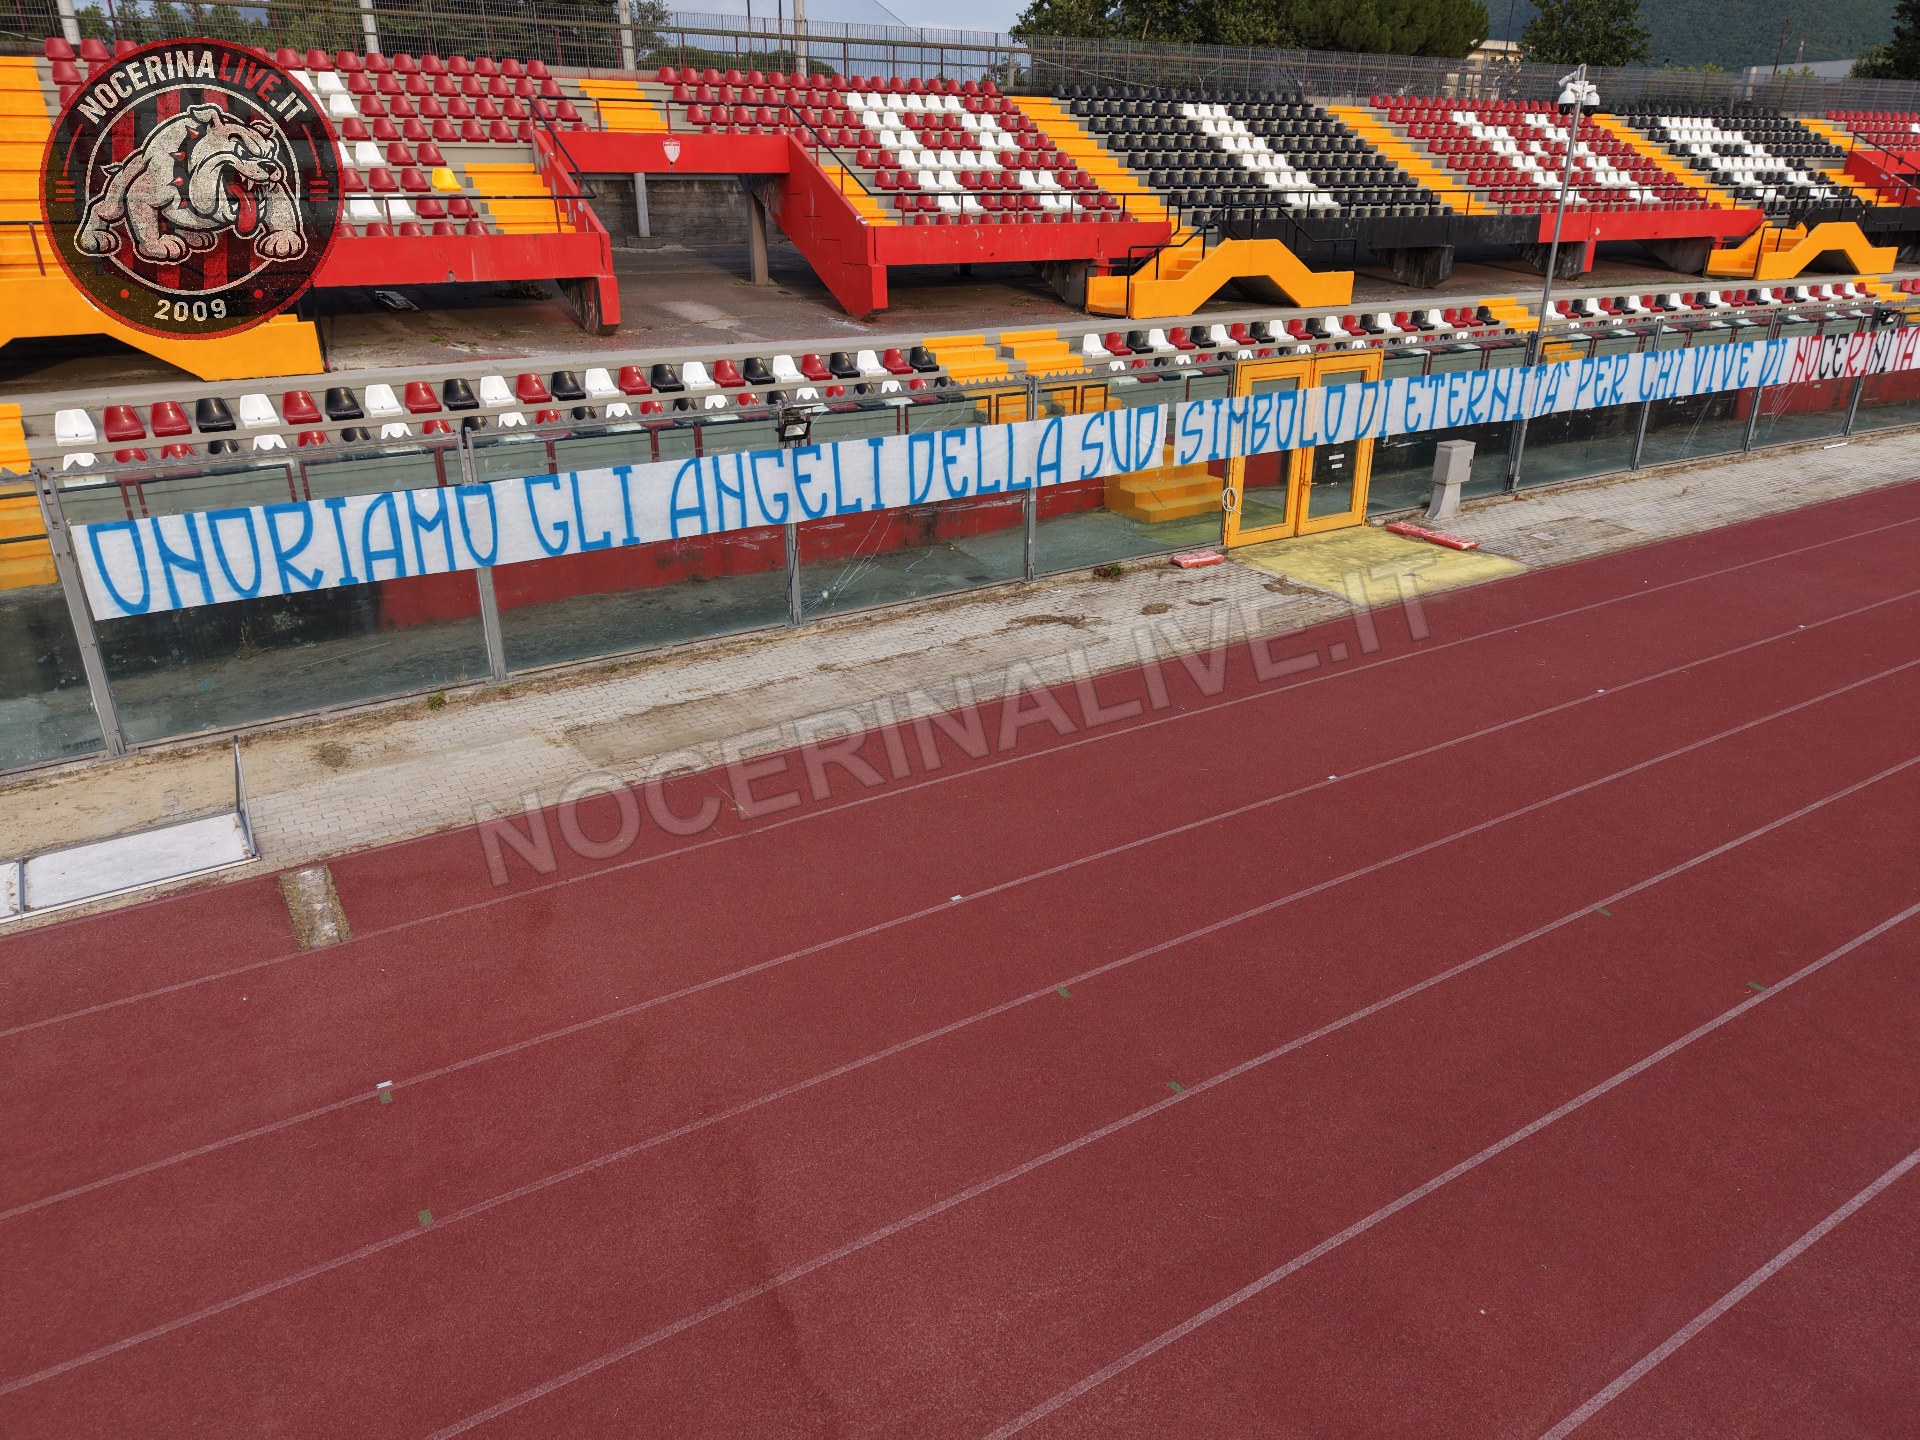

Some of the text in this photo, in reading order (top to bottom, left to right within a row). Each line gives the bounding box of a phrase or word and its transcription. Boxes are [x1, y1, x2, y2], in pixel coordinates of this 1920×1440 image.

[87, 483, 498, 617] ONORIAMO
[523, 466, 640, 556] GLI
[669, 437, 885, 539] ANGELI
[907, 416, 1063, 505] DELLA
[1080, 404, 1160, 480] SUD
[1180, 383, 1347, 465] SIMBOLO
[1354, 379, 1393, 440] DI
[1574, 353, 1630, 410] PER
[1638, 348, 1686, 403] CHI
[1692, 341, 1755, 396] VIVE
[1758, 338, 1788, 388] DI
